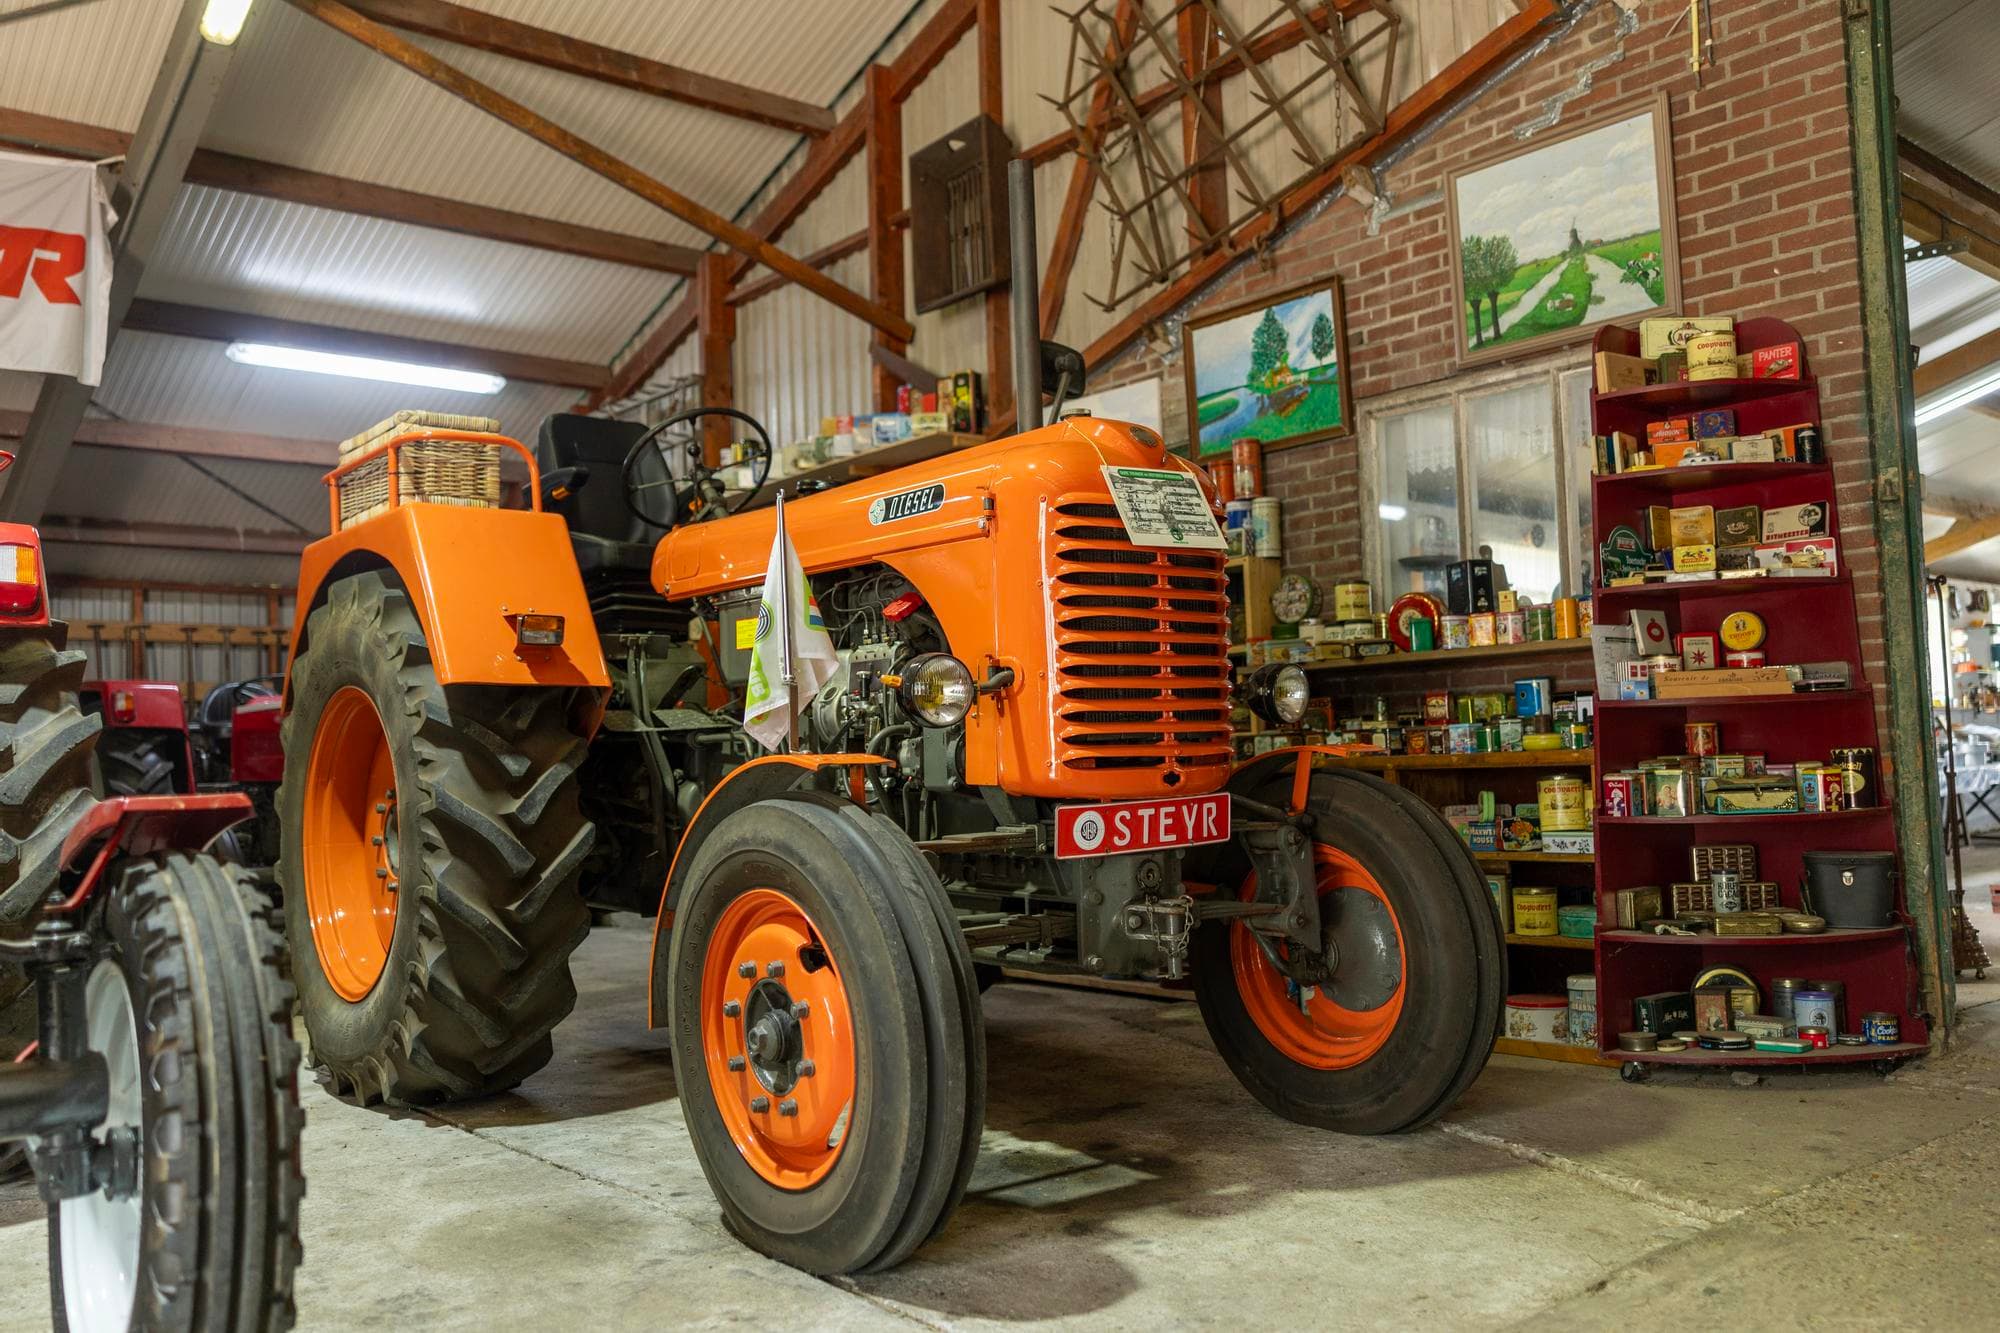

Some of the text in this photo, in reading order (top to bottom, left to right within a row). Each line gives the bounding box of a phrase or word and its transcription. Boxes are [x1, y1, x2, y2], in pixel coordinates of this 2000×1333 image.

[1758, 346, 1792, 362] PANTER
[889, 487, 936, 518] DIESEL
[1113, 802, 1218, 847] STEYR
